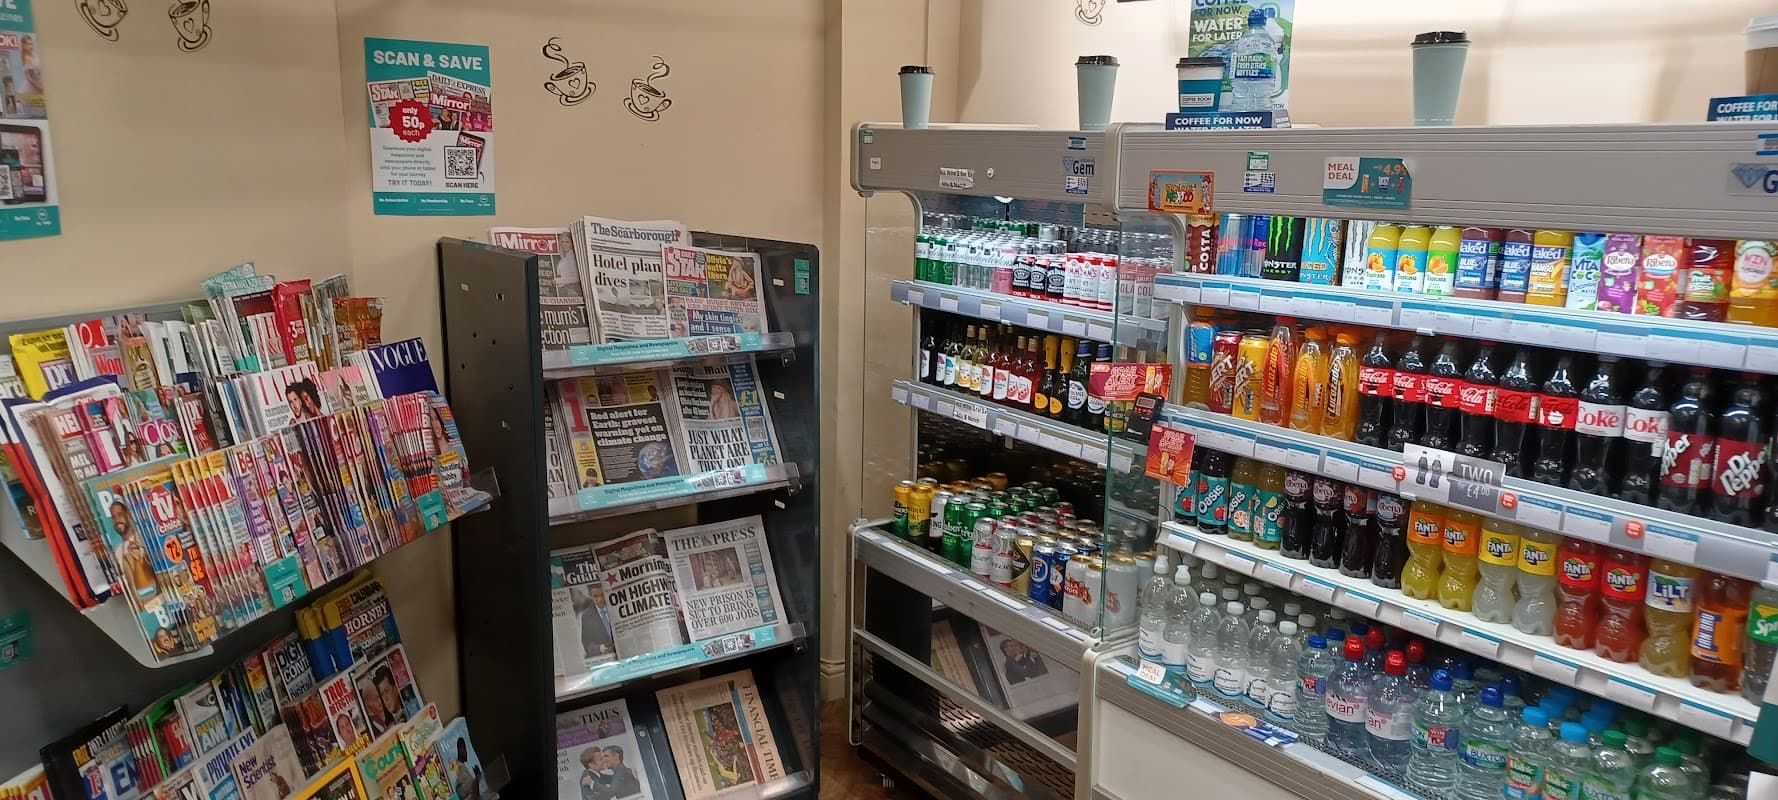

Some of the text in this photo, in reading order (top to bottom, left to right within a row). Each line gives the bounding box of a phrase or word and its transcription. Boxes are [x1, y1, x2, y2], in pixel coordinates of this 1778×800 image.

[1195, 7, 1213, 16] FOR
[1194, 18, 1244, 32] WATER
[1192, 31, 1243, 42] FOR LATER
[373, 50, 483, 71] SCAN & SAVE
[431, 94, 470, 110] Mirror
[1718, 103, 1755, 113] COFFEE
[402, 107, 418, 115] only
[402, 116, 425, 130] 50p
[1175, 116, 1262, 125] COFFEE FOR NOW
[402, 129, 421, 137] each
[1073, 161, 1095, 176] Gem
[1328, 163, 1355, 171] MEAL
[1328, 172, 1353, 180] DEAL
[590, 222, 679, 243] The Scarborough
[500, 233, 556, 251] Mirror
[1199, 228, 1211, 271] COSTA
[592, 254, 661, 275] Hotel plan
[667, 251, 706, 280] STAR
[1574, 259, 1598, 272] VITA
[1606, 255, 1634, 267] Ribena
[1646, 257, 1675, 269] Ribena
[594, 272, 628, 288] dives
[544, 306, 579, 326] mum's
[690, 323, 704, 332] and
[370, 339, 428, 374] VOGUE
[1265, 344, 1281, 398] Lucozade
[1296, 362, 1309, 410] Lucozade
[1327, 357, 1342, 414] Lucozade
[590, 408, 648, 420] Red alert for
[592, 416, 657, 428] Earth: gravest
[1577, 407, 1620, 428] Coke
[594, 427, 634, 437] warning
[635, 426, 650, 435] yet
[597, 433, 667, 447] climate change
[688, 427, 744, 445] JUST WHAT
[689, 442, 750, 460] PLANET ARE
[1661, 434, 1690, 476] pper
[1728, 451, 1751, 473] Dr
[1460, 463, 1493, 485] TWO
[1198, 485, 1224, 514] Oasis
[1414, 520, 1439, 533] FANTA
[1443, 528, 1465, 541] FANTA
[671, 527, 756, 552] THE PRESS
[1487, 539, 1512, 552] FANTA
[1522, 547, 1549, 561] FANTA
[1562, 560, 1591, 576] FANTA
[566, 571, 601, 585] Guar
[1607, 570, 1637, 586] FANTA
[608, 578, 669, 608] ON HIGHW
[686, 588, 754, 610] NEW PRISON IS
[618, 596, 671, 619] CLIMATE
[688, 598, 754, 620] SET TO BRING
[344, 600, 388, 635] HORNBY
[691, 607, 760, 630] OVER 600 JOBS
[1754, 619, 1778, 637] Spr
[323, 678, 349, 704] TRUE
[581, 707, 620, 724] TIMES
[1327, 700, 1354, 716] evian
[742, 685, 778, 781] FINANCIAL TIME
[206, 742, 240, 785] PRIVATE
[1471, 749, 1506, 762] BUXTON
[239, 754, 258, 777] New
[243, 755, 276, 789] Scientist
